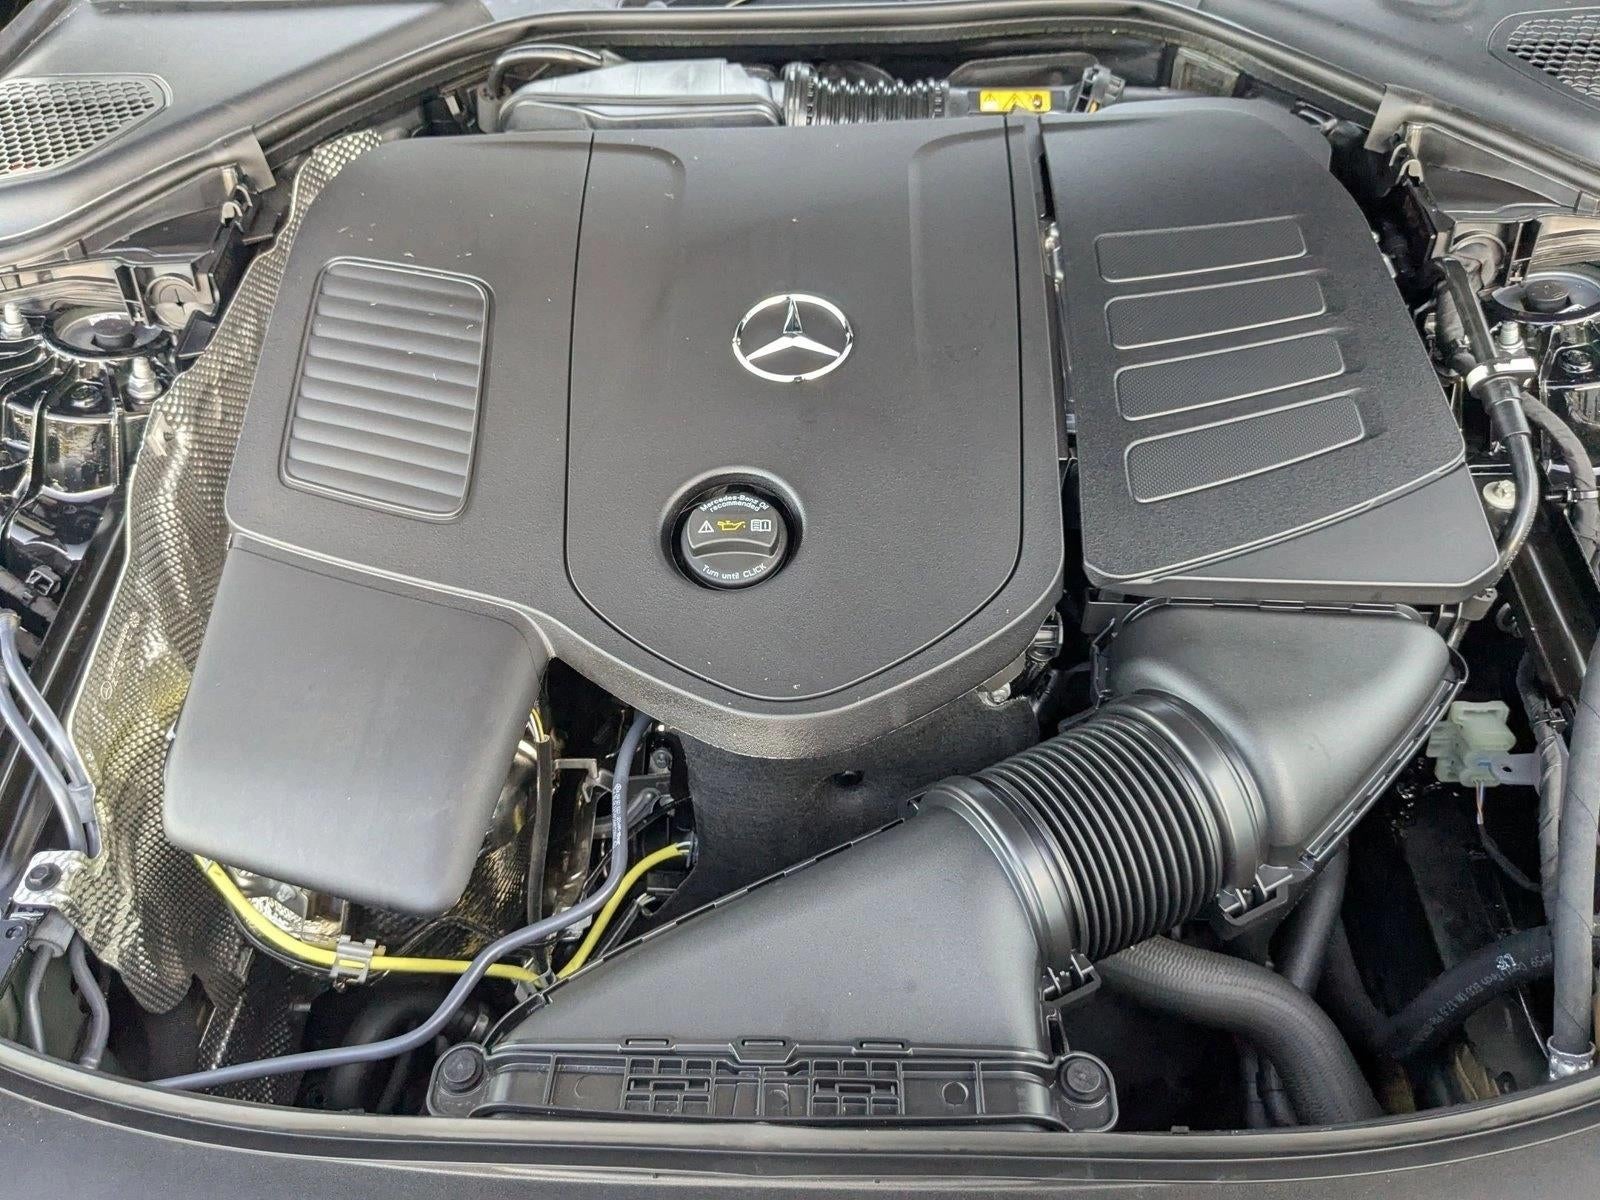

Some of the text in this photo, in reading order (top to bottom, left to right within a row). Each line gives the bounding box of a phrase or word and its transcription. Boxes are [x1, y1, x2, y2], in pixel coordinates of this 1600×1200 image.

[700, 495, 770, 511] Mercedes-Benz Oil
[710, 501, 760, 512] recommended
[703, 564, 719, 577] Turn
[743, 563, 766, 578] CLICK
